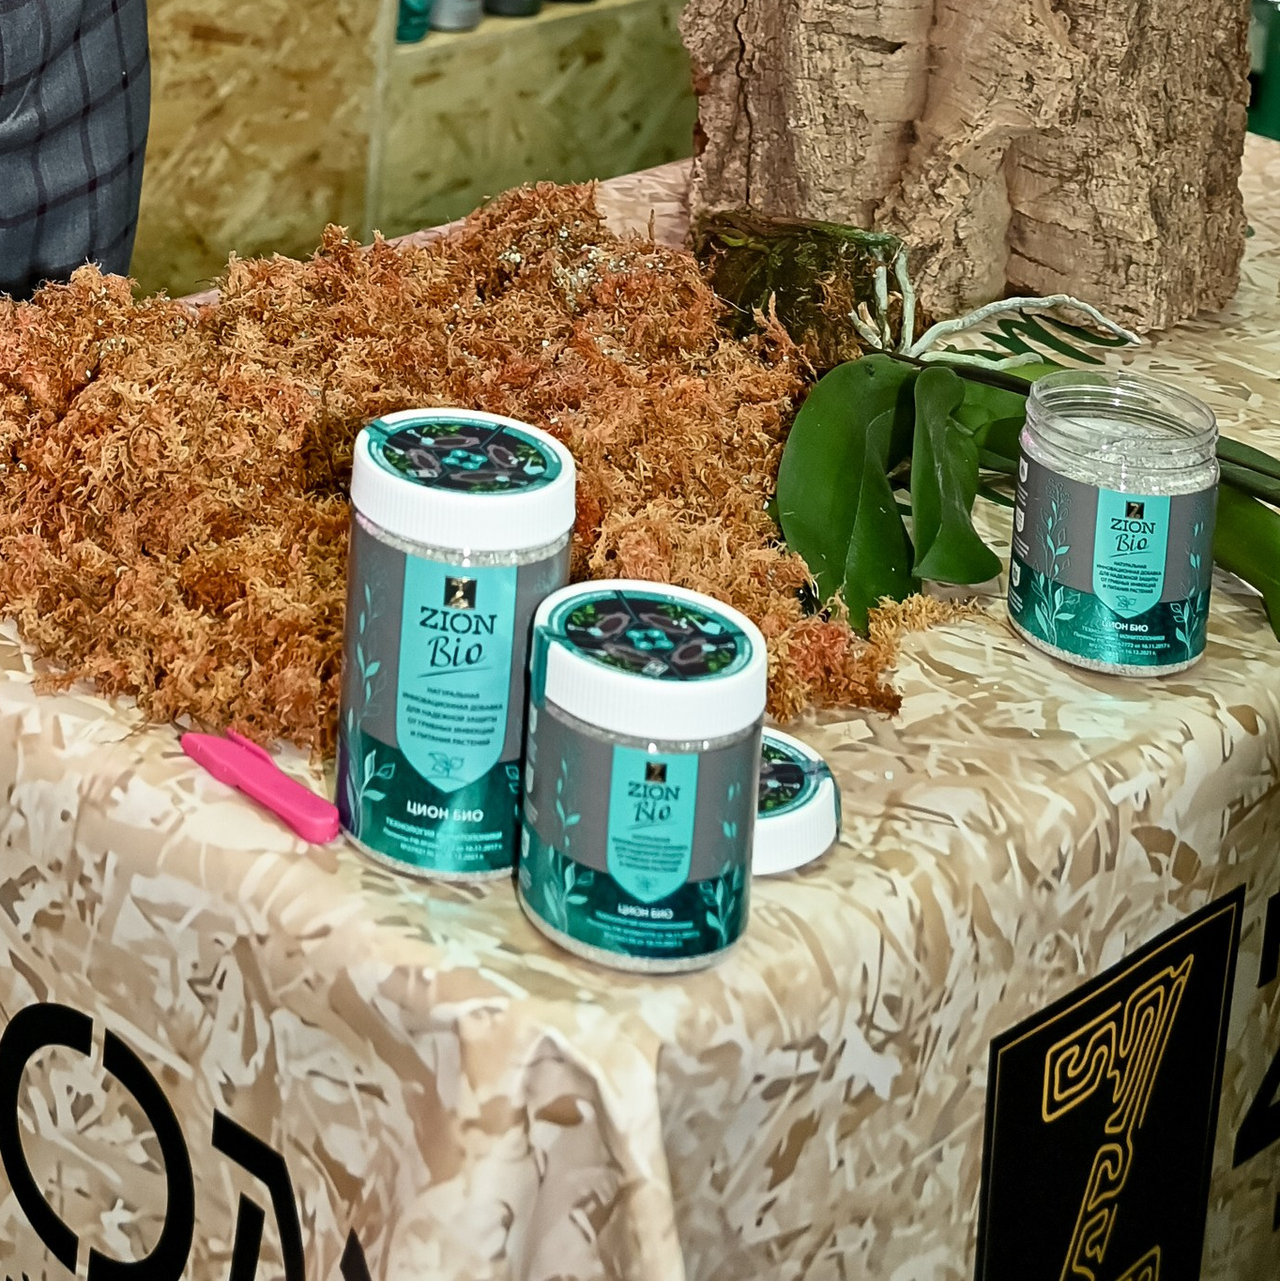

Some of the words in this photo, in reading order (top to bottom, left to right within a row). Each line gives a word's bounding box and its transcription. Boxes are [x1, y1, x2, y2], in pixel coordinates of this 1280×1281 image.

[1110, 518, 1155, 534] ZION
[1115, 534, 1149, 552] Bio
[419, 606, 497, 635] ZION
[1102, 620, 1128, 631] ЦИОН
[1130, 624, 1149, 632] БИО
[427, 635, 484, 667] Bio
[627, 780, 680, 801] ZION
[406, 799, 449, 820] ЦИОН
[453, 808, 484, 823] БИО
